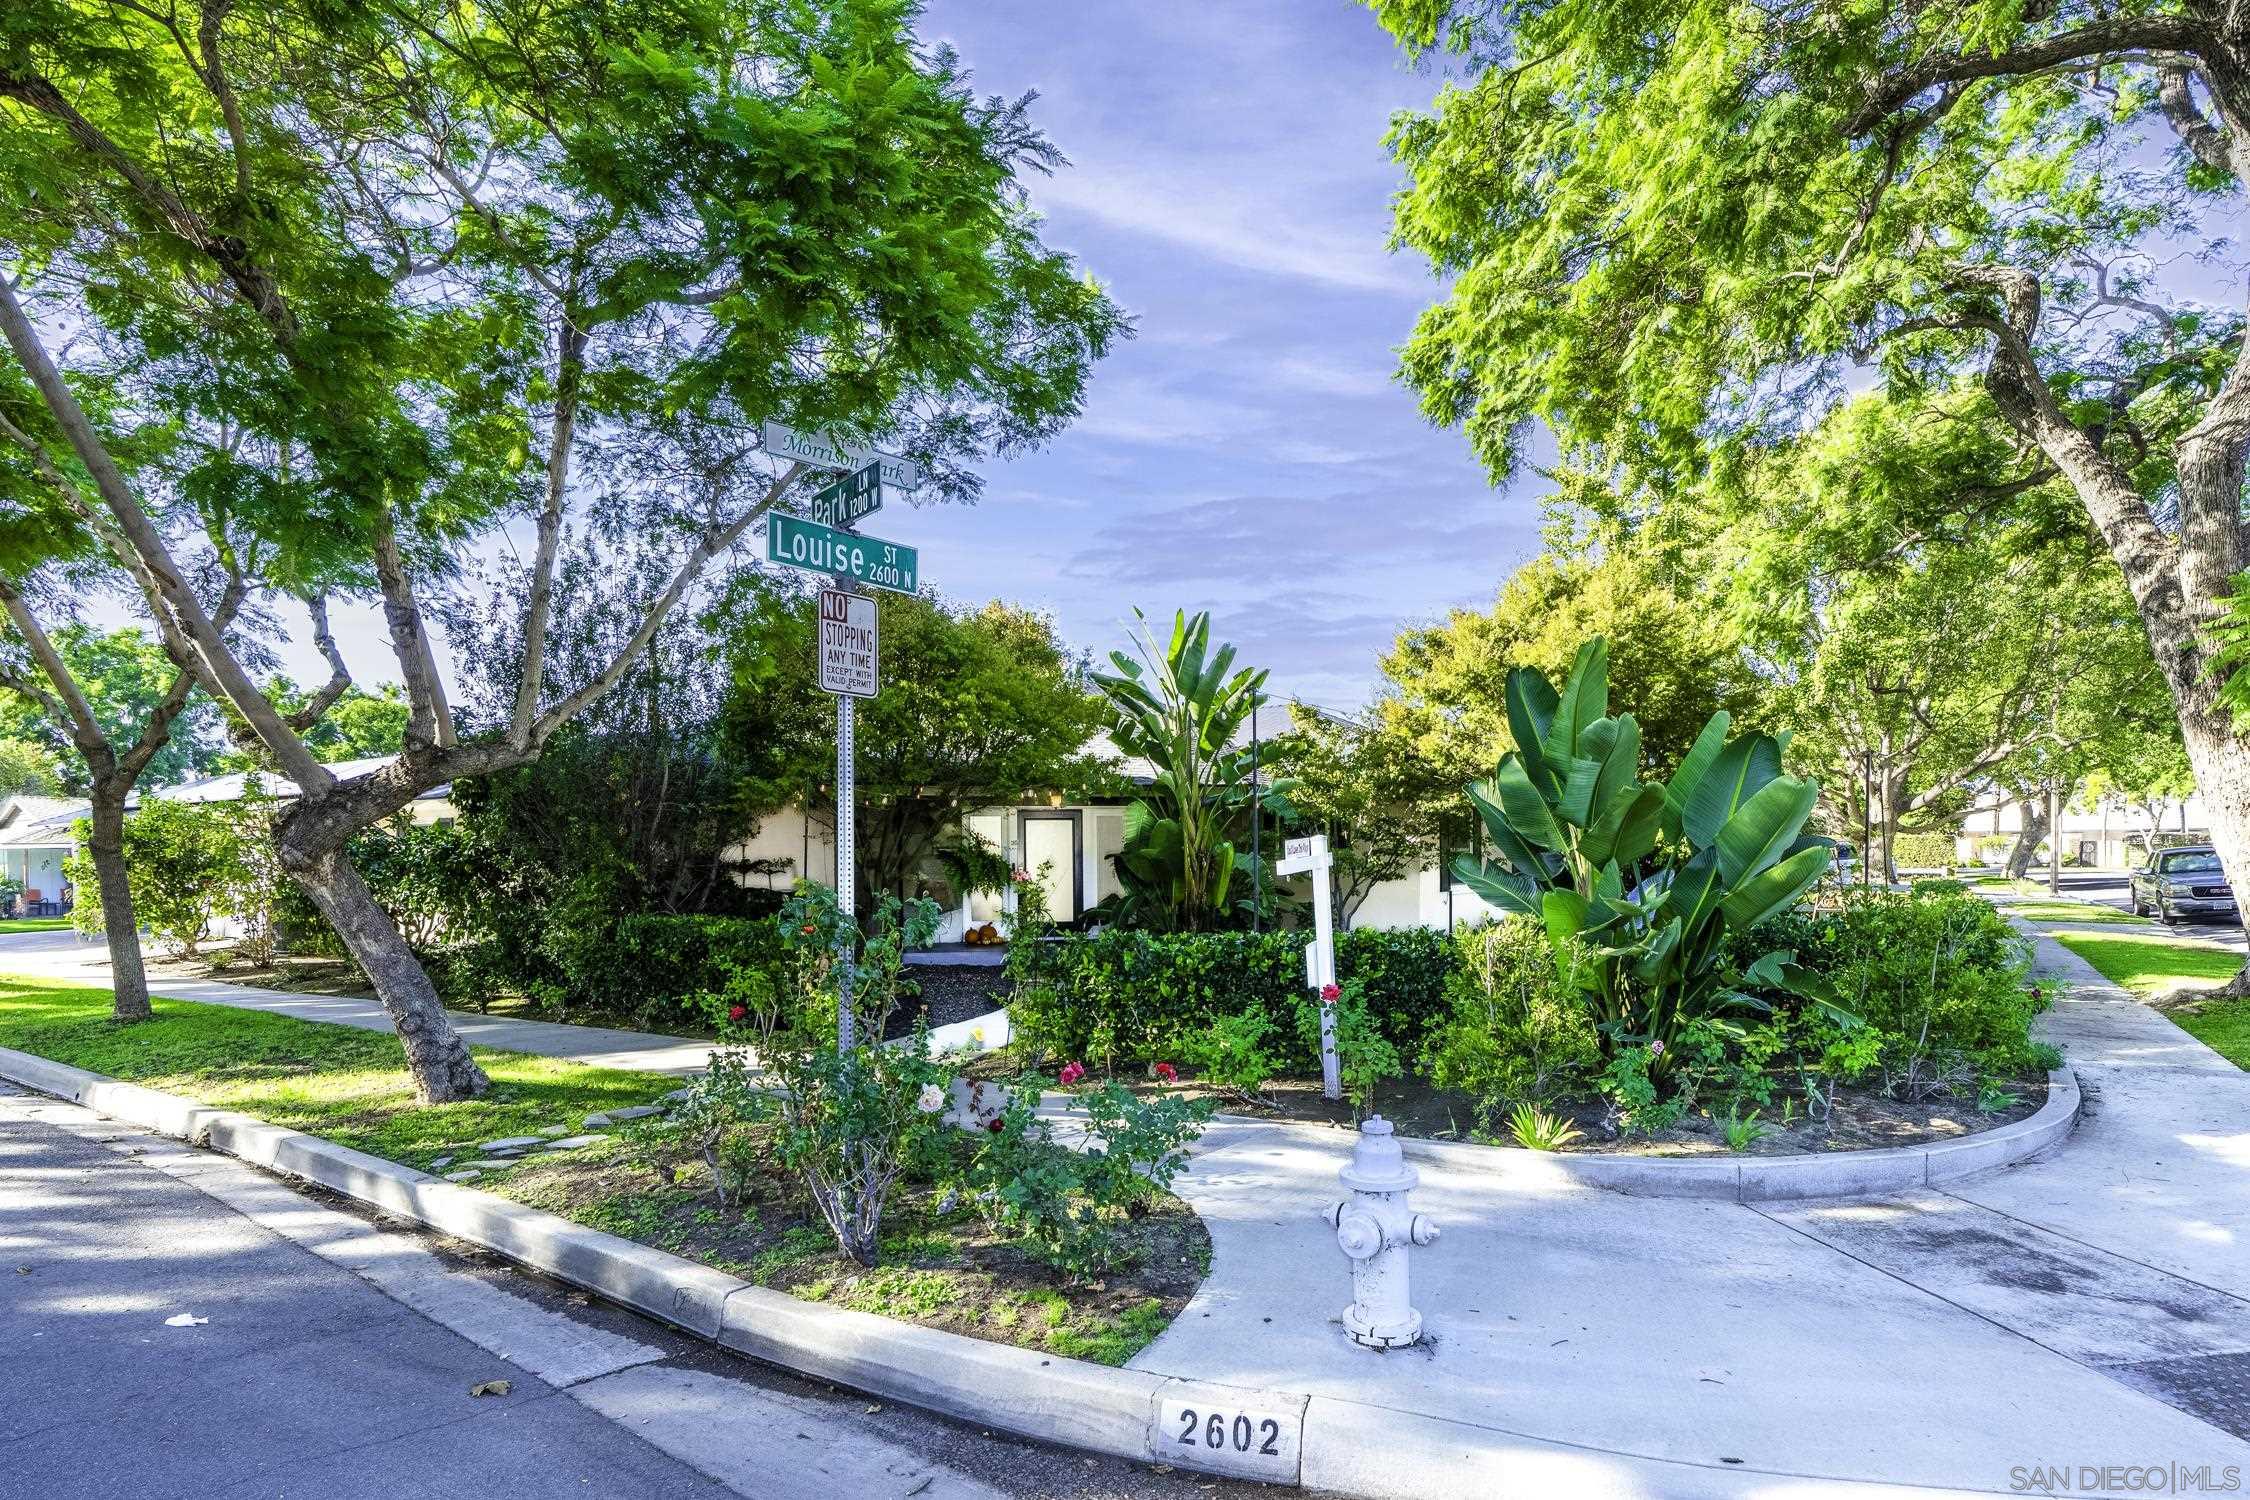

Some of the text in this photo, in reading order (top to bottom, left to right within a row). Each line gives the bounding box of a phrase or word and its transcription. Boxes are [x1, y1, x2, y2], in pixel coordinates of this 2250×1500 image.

[783, 434, 859, 469] Morrison
[859, 470, 868, 492] LN
[815, 488, 847, 526] Park
[850, 487, 878, 518] 1200 W
[776, 520, 897, 576] Louise ST
[870, 562, 912, 589] 2600 N
[823, 592, 846, 620] NO
[826, 622, 872, 652] STOPPING
[826, 664, 872, 680] EXCEPT WITH
[827, 648, 871, 669] ANY TIME
[826, 674, 872, 689] VALID PERMIT
[1177, 1408, 1280, 1456] 2602
